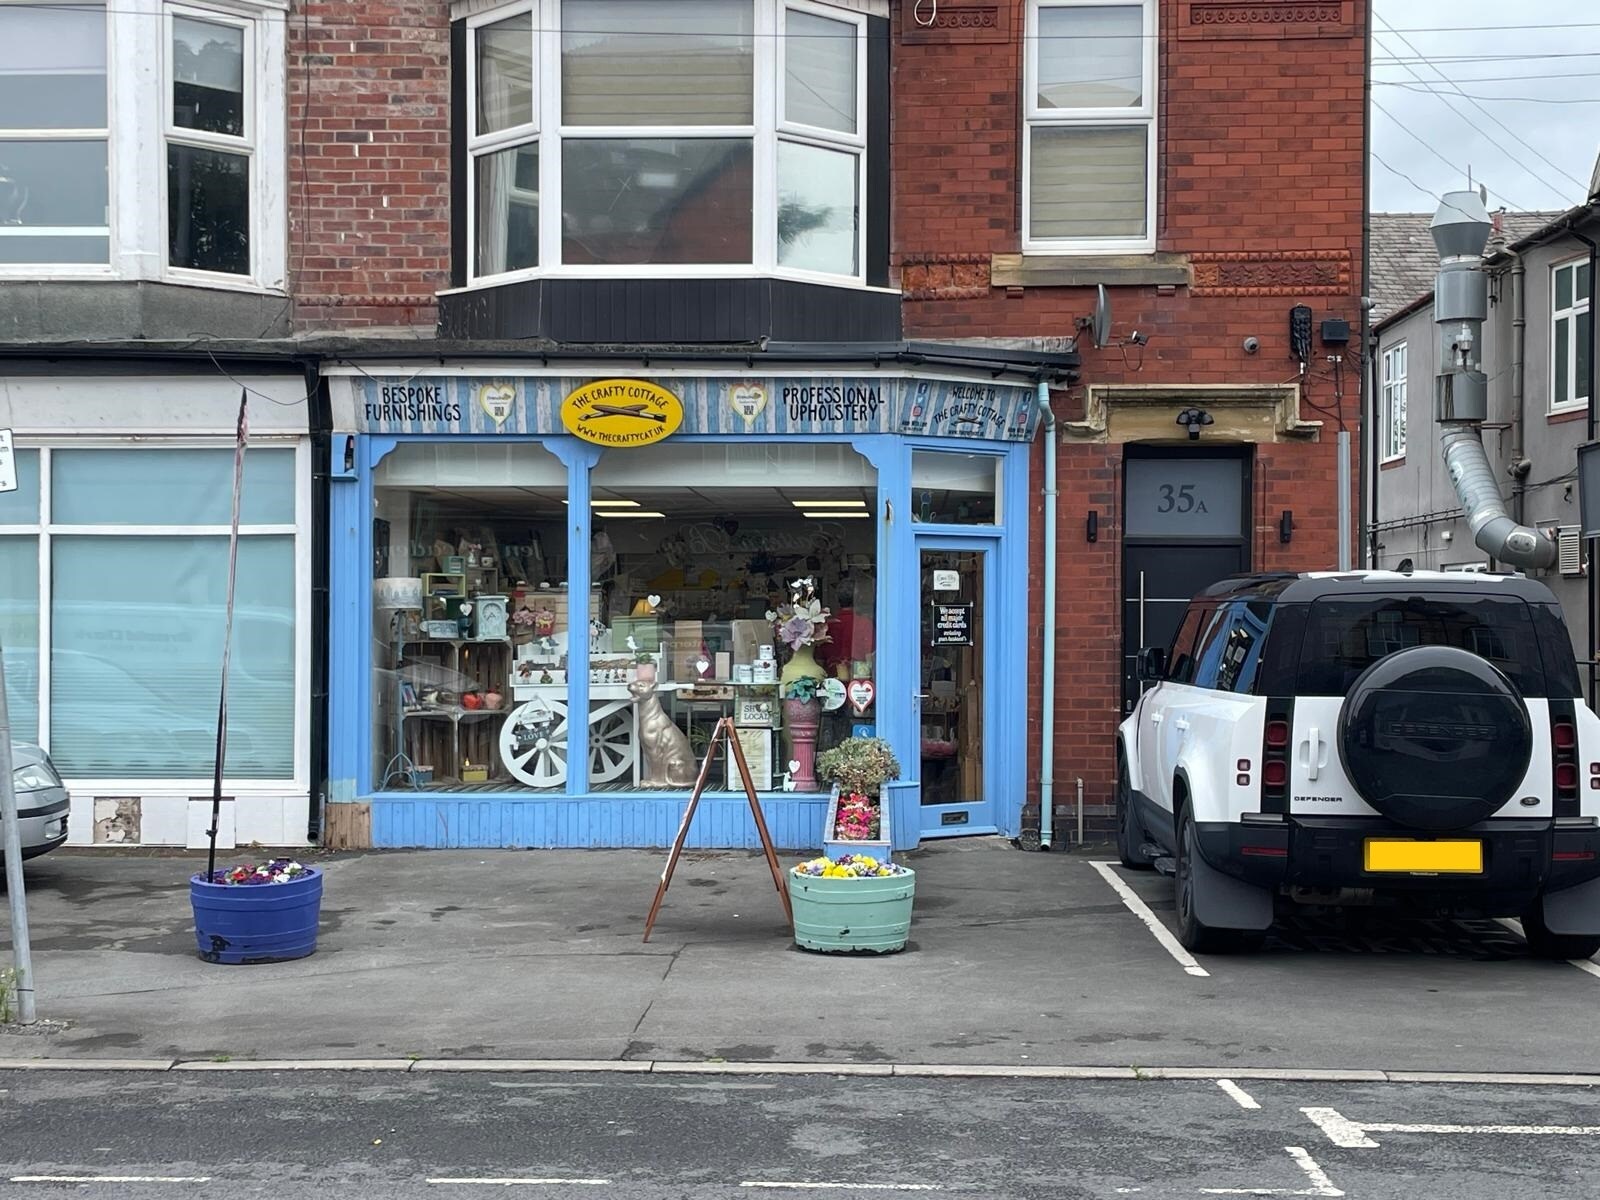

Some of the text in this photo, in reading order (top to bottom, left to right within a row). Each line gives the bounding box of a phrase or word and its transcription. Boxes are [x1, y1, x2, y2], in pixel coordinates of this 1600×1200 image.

[382, 386, 442, 405] BESPOKE
[572, 385, 669, 410] THE CRAFTY COTTAGE
[783, 386, 885, 405] PROFESSIONAL
[952, 385, 996, 402] WELCOME TO
[365, 403, 462, 422] FURNISHINGS
[790, 403, 879, 422] UPHOLSTERY
[933, 403, 1006, 429] THE CRAFTY COTTAGE
[1157, 483, 1209, 513] 35A
[937, 621, 967, 629] credit cards
[744, 713, 769, 721] LOCAL
[523, 731, 544, 741] LOVE
[1391, 723, 1490, 736] DEFENDER
